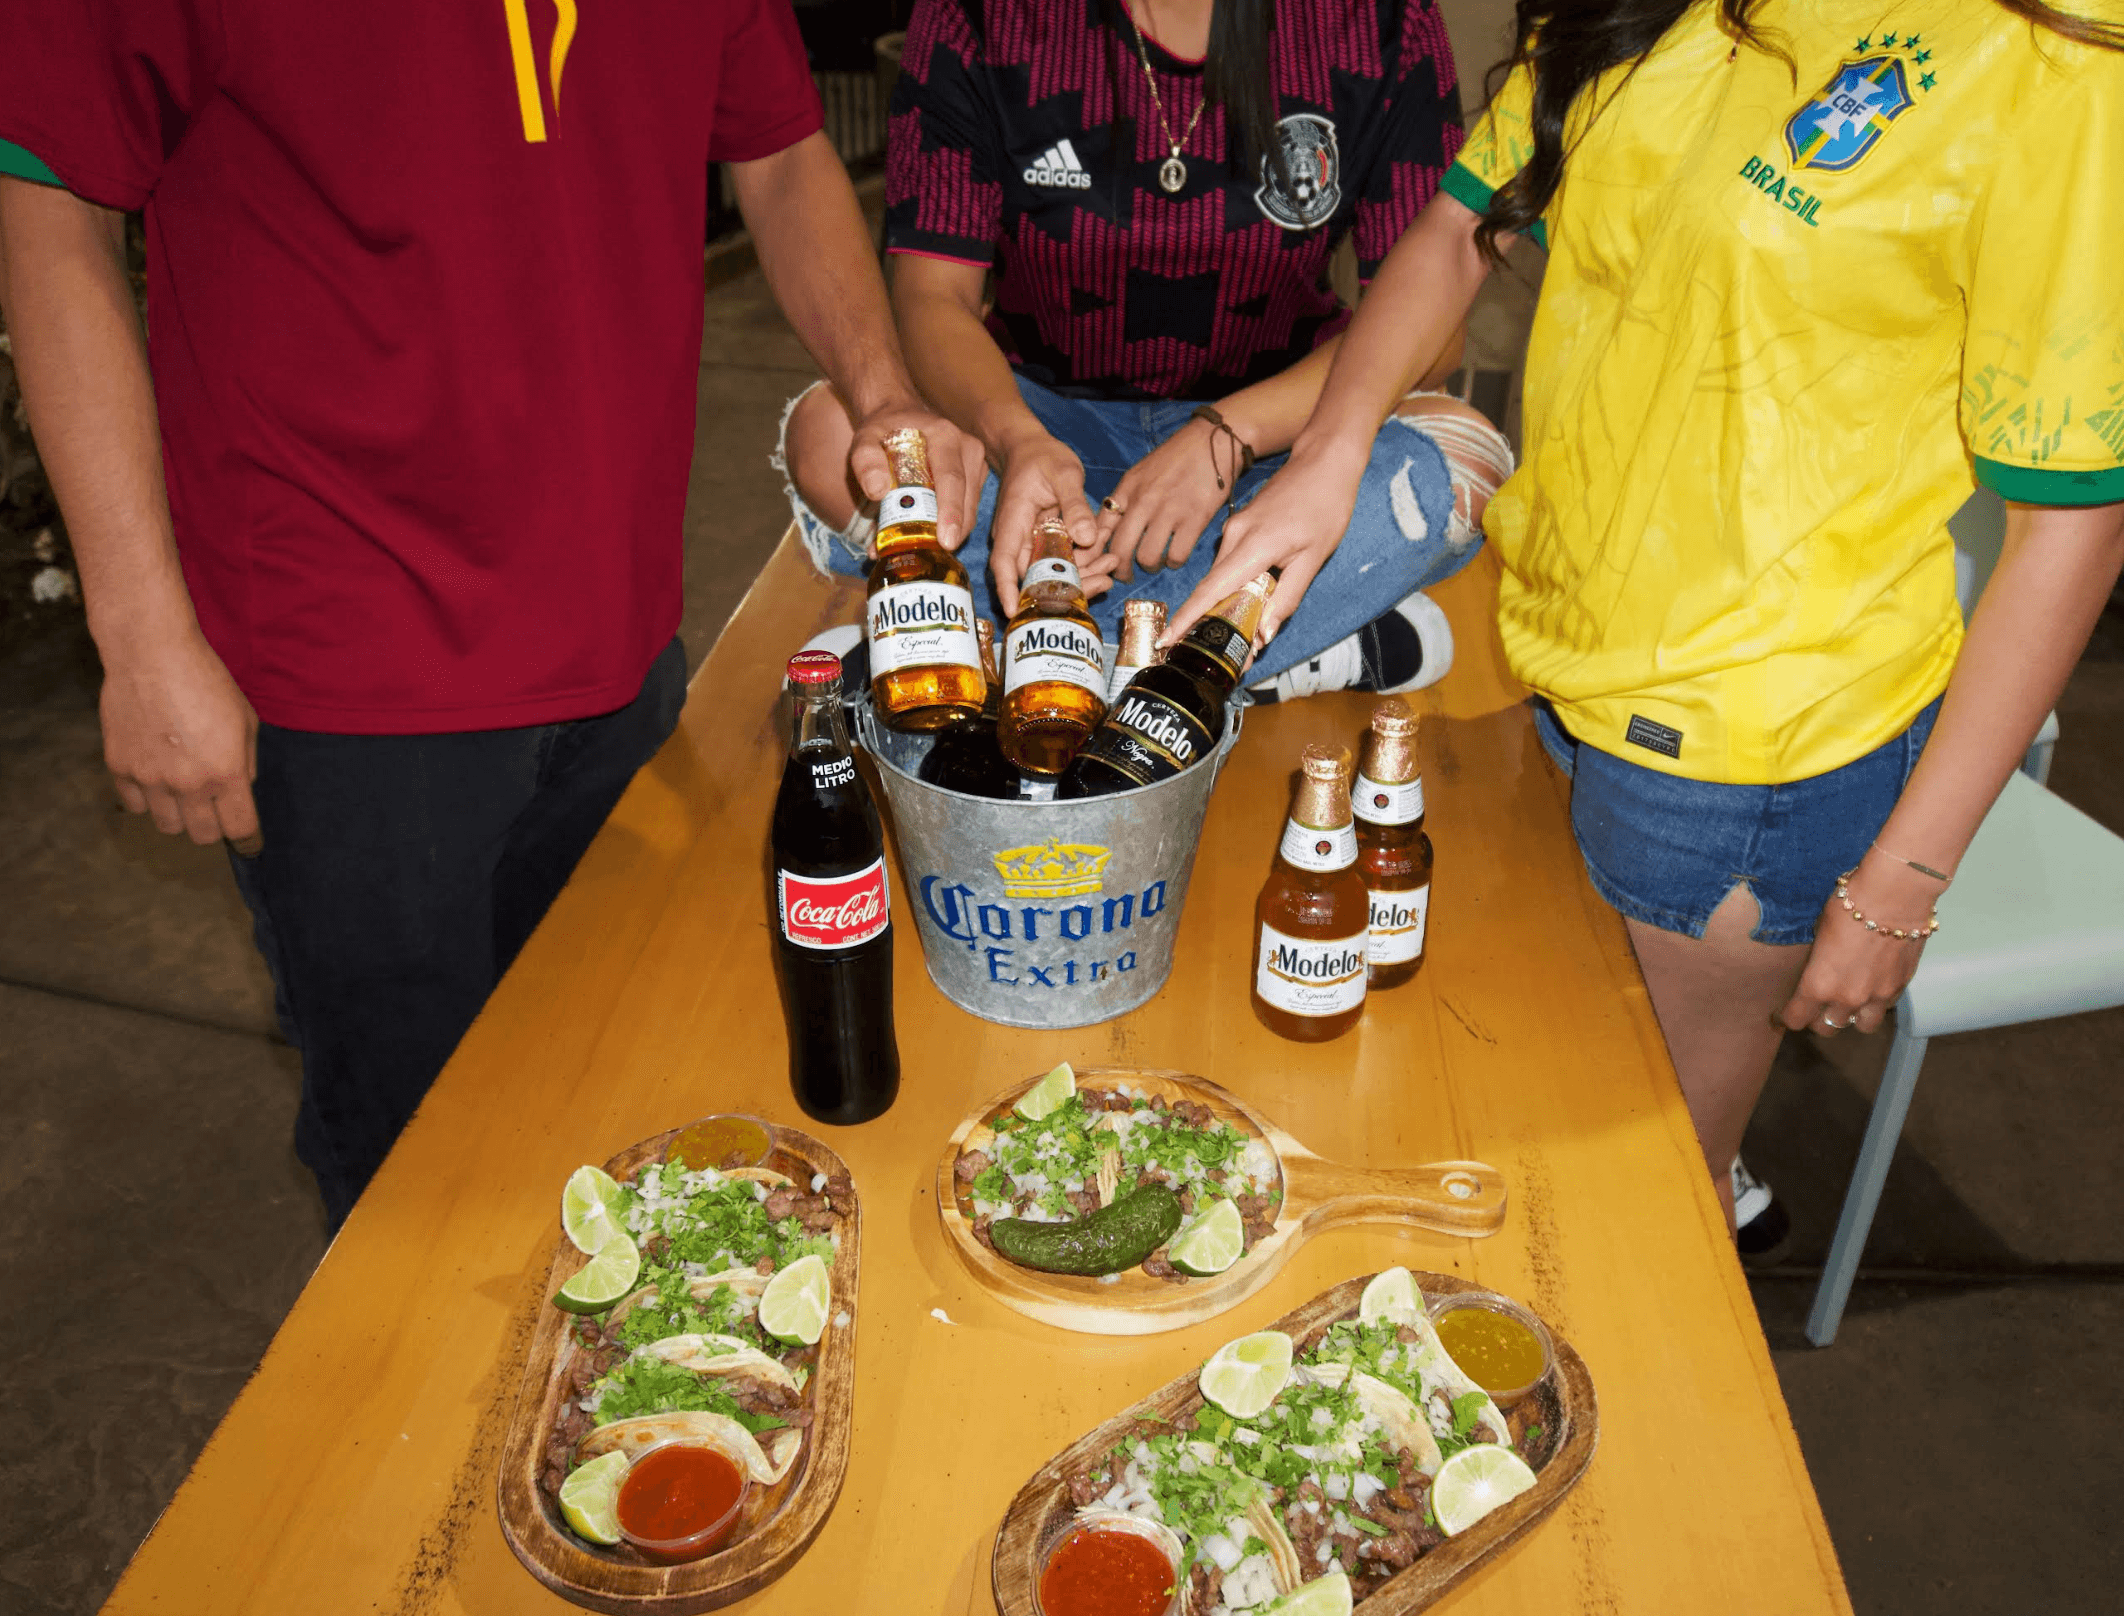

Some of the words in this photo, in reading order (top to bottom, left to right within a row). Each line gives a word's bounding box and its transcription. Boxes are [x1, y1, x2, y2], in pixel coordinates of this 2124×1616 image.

[1832, 93, 1867, 118] CBF
[1023, 167, 1091, 188] adidas
[1739, 155, 1822, 227] BRASIL
[879, 594, 959, 630] Modelo
[1025, 627, 1099, 664] Modelo
[1116, 697, 1192, 760] Modelo
[1151, 702, 1181, 723] CERVEZA
[812, 755, 853, 777] MEDIO
[815, 768, 855, 789] LITRO
[790, 883, 882, 930] Coca-Cola
[920, 876, 1166, 951] Corona
[984, 946, 1136, 987] Extra
[1278, 943, 1357, 977] Modelo
